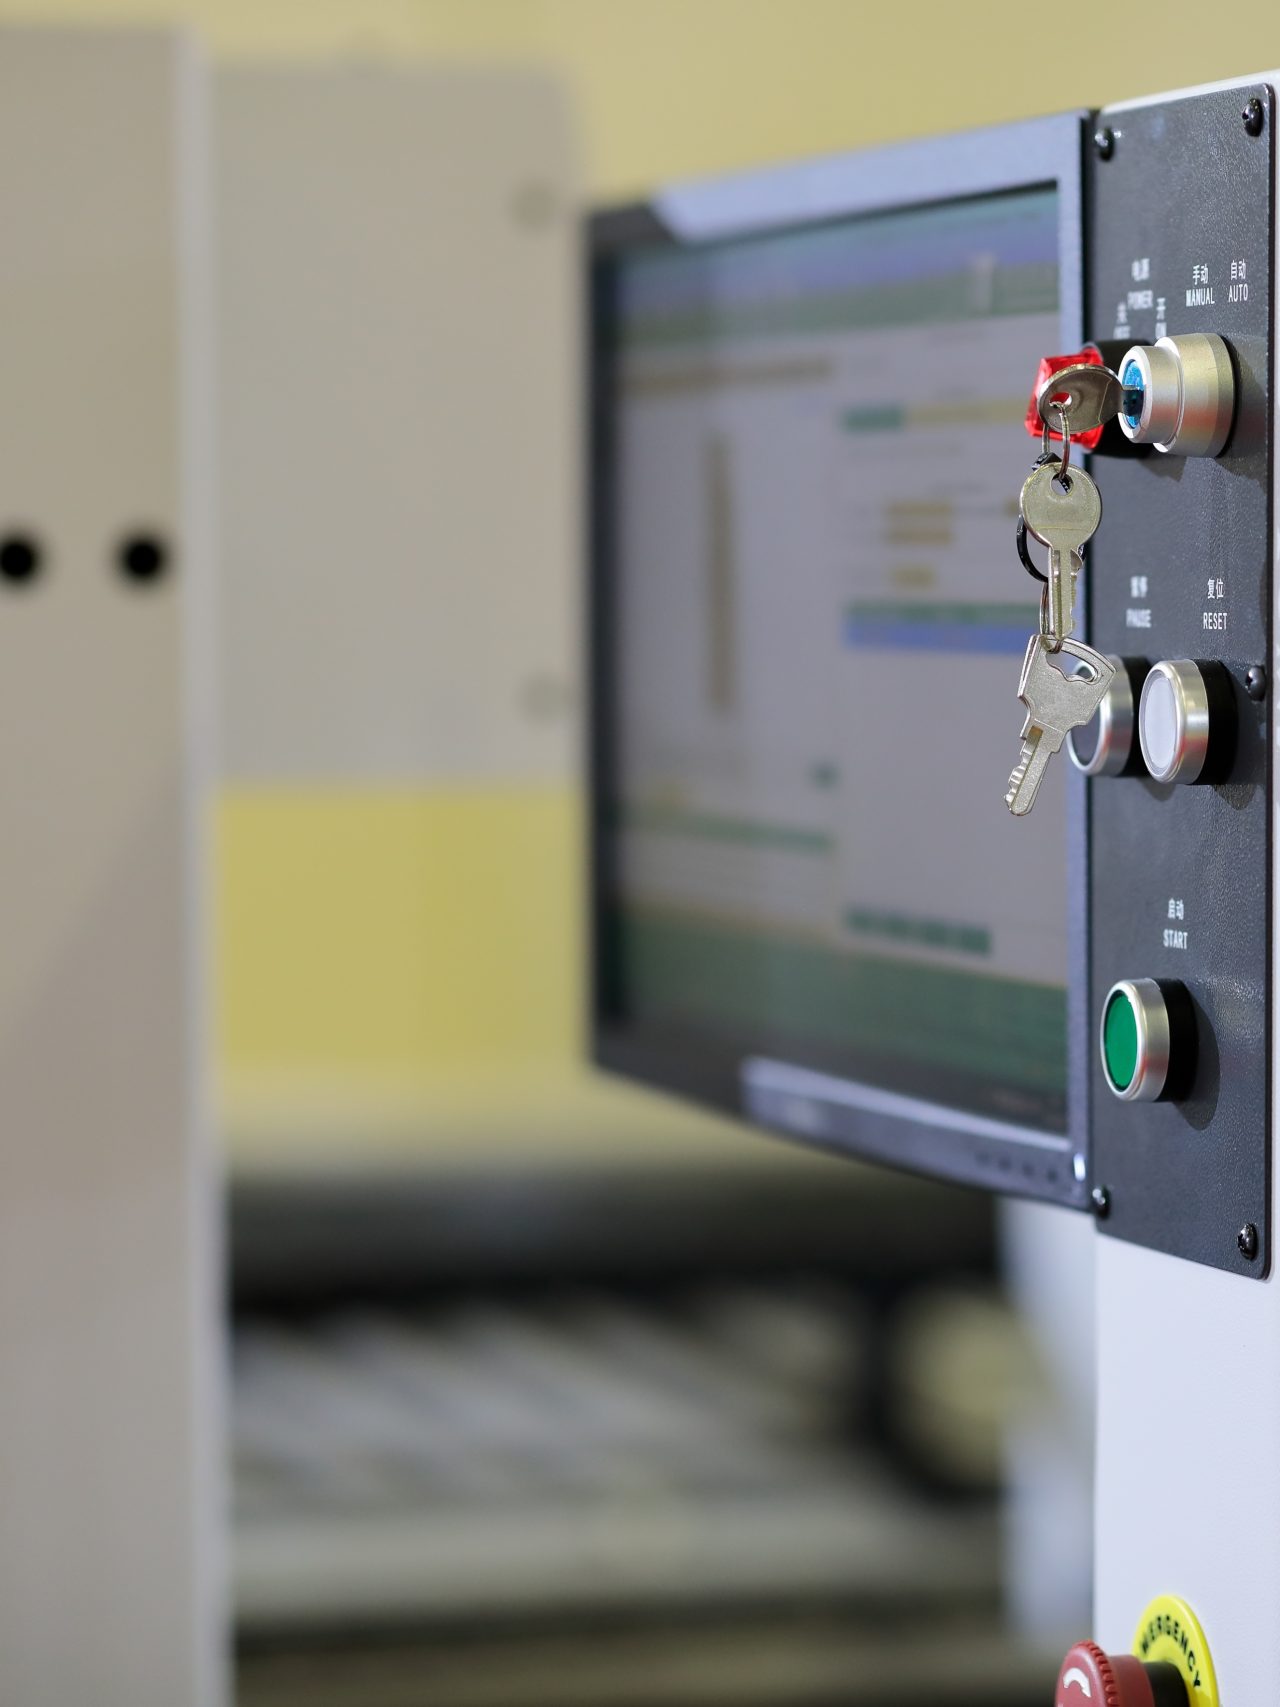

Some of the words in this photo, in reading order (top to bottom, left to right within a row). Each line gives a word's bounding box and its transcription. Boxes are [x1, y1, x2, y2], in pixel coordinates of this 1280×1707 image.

[1192, 263, 1209, 285] 手动
[1230, 258, 1247, 281] 自动
[1186, 287, 1215, 307] MANUAL
[1228, 283, 1249, 303] AUTO
[1207, 578, 1224, 599] 复位
[1203, 612, 1228, 630] RESET
[1167, 898, 1184, 920] 启动
[1163, 928, 1188, 949] START
[1140, 1613, 1201, 1689] MERGENCY
